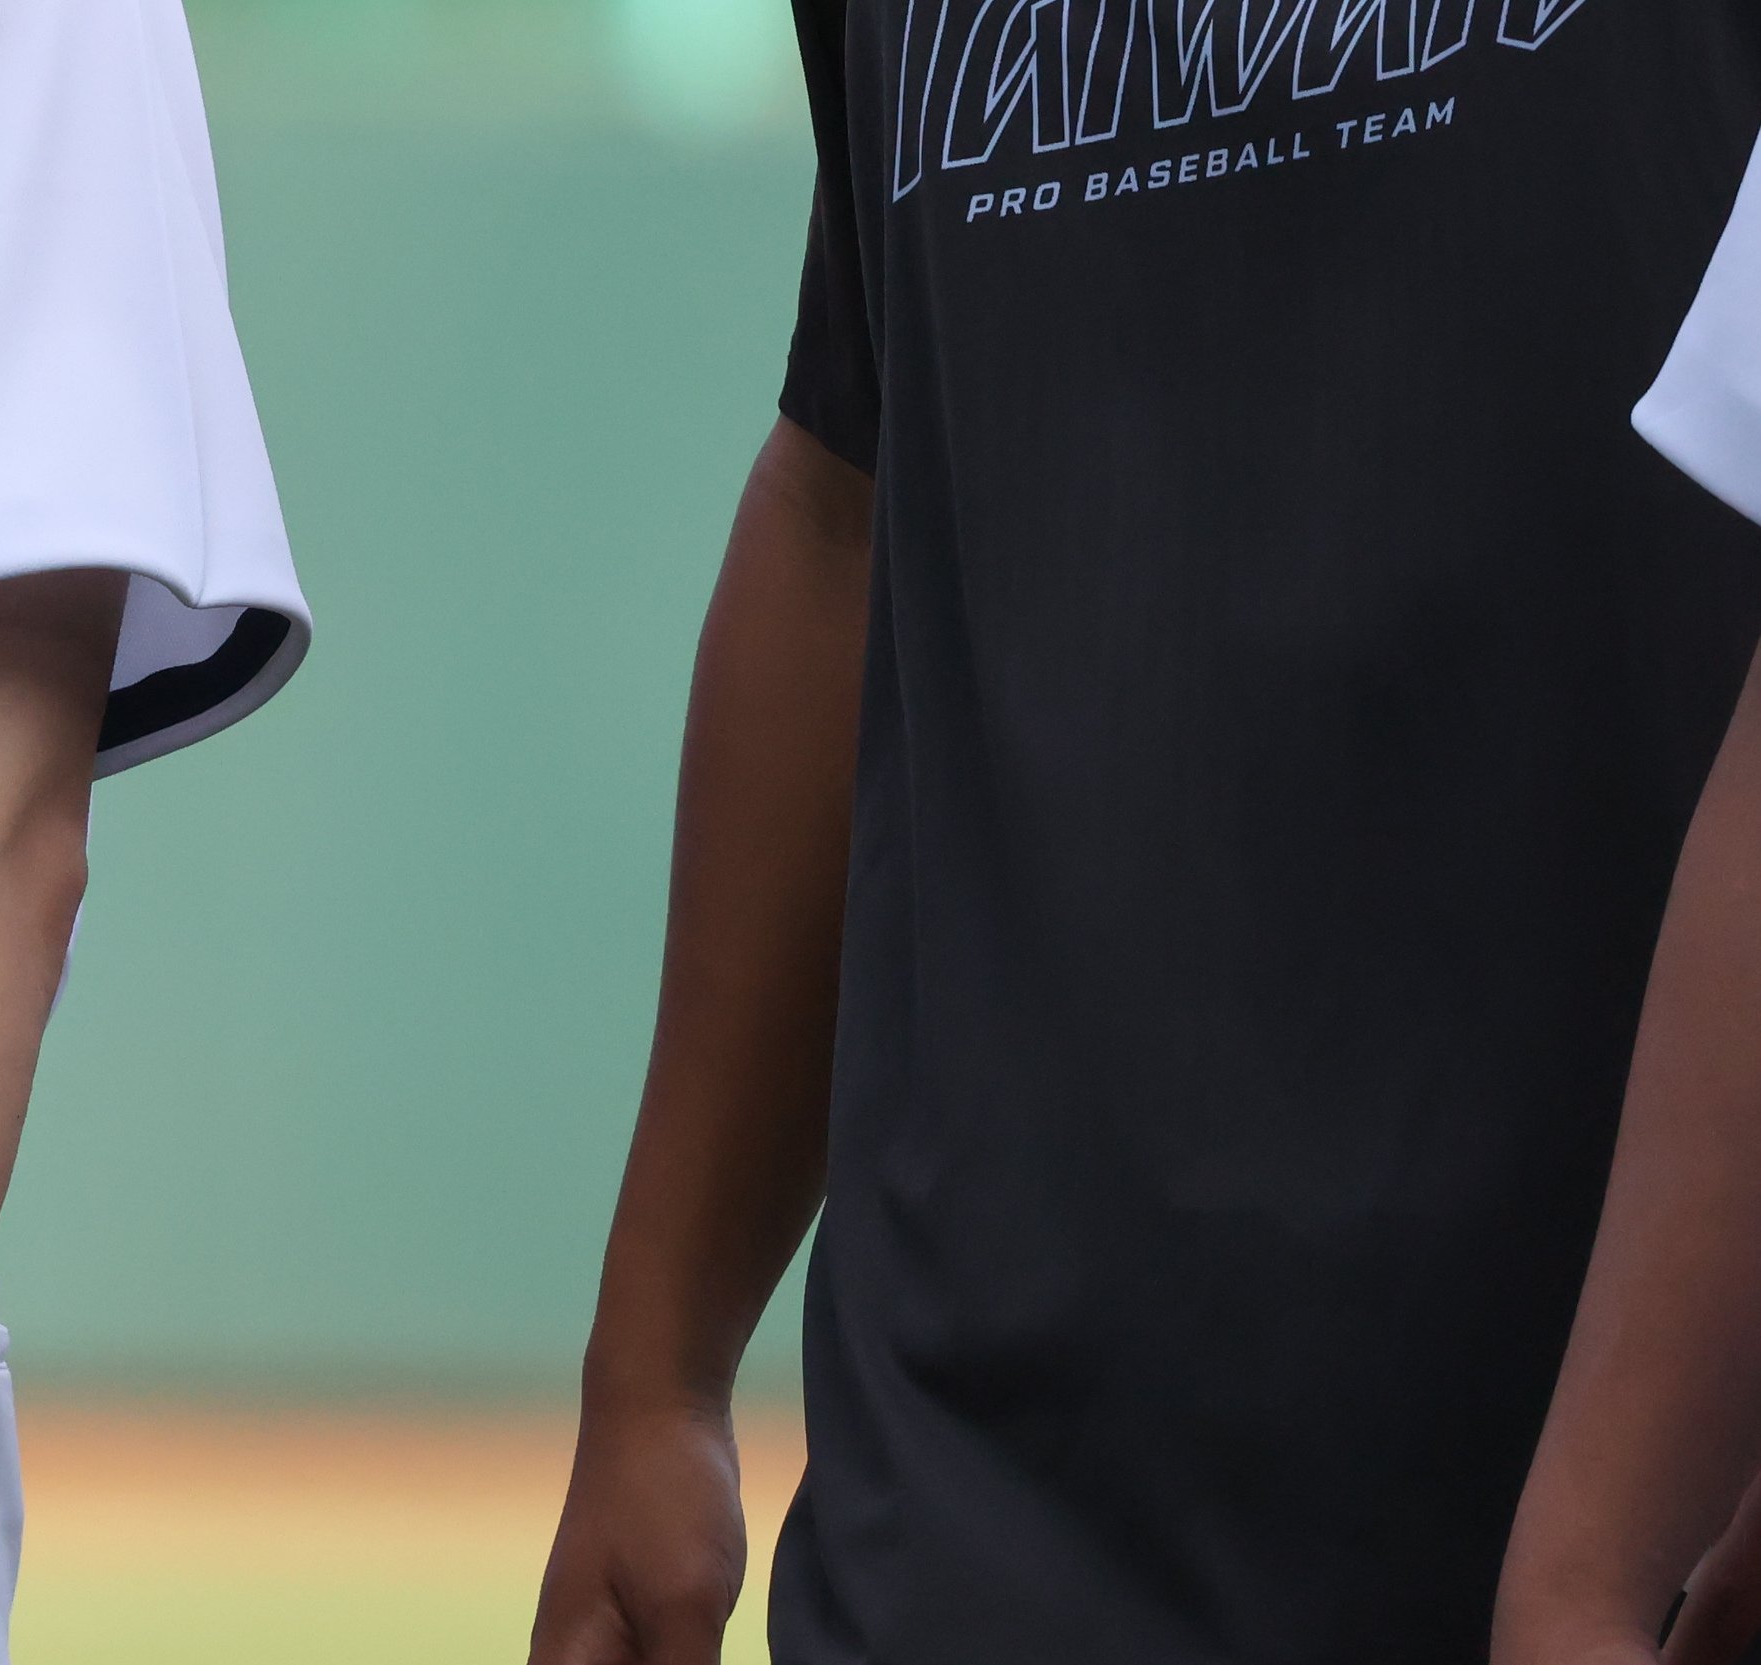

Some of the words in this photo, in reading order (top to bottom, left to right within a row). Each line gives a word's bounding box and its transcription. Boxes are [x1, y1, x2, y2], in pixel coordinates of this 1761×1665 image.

[965, 181, 1061, 224] PRO
[1084, 133, 1311, 203] BASEBALL
[1336, 96, 1456, 149] TEAM
